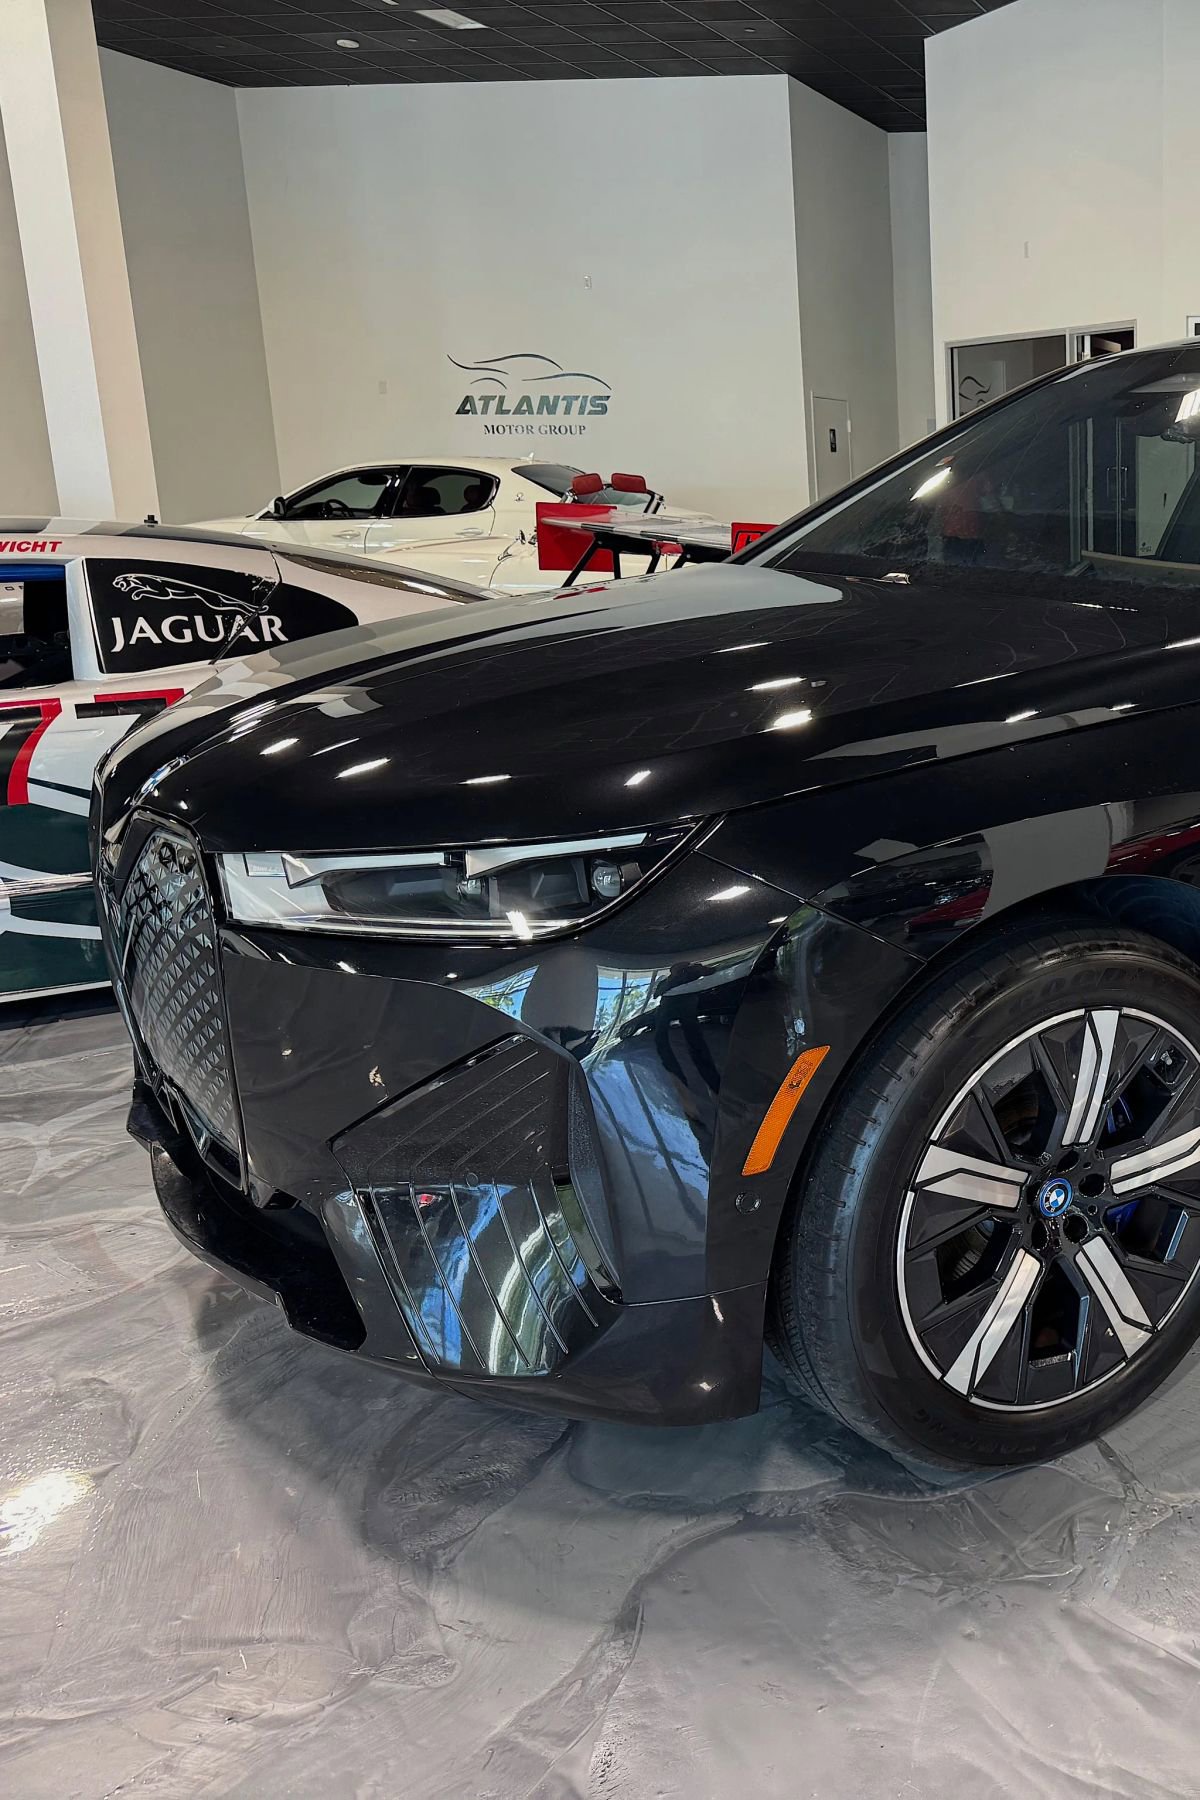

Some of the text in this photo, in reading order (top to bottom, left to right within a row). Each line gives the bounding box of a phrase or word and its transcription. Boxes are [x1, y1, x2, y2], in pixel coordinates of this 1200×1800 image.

[455, 395, 611, 416] ATLANTIS
[484, 424, 587, 436] MOTOR GROUP
[110, 614, 289, 653] JAGUAR
